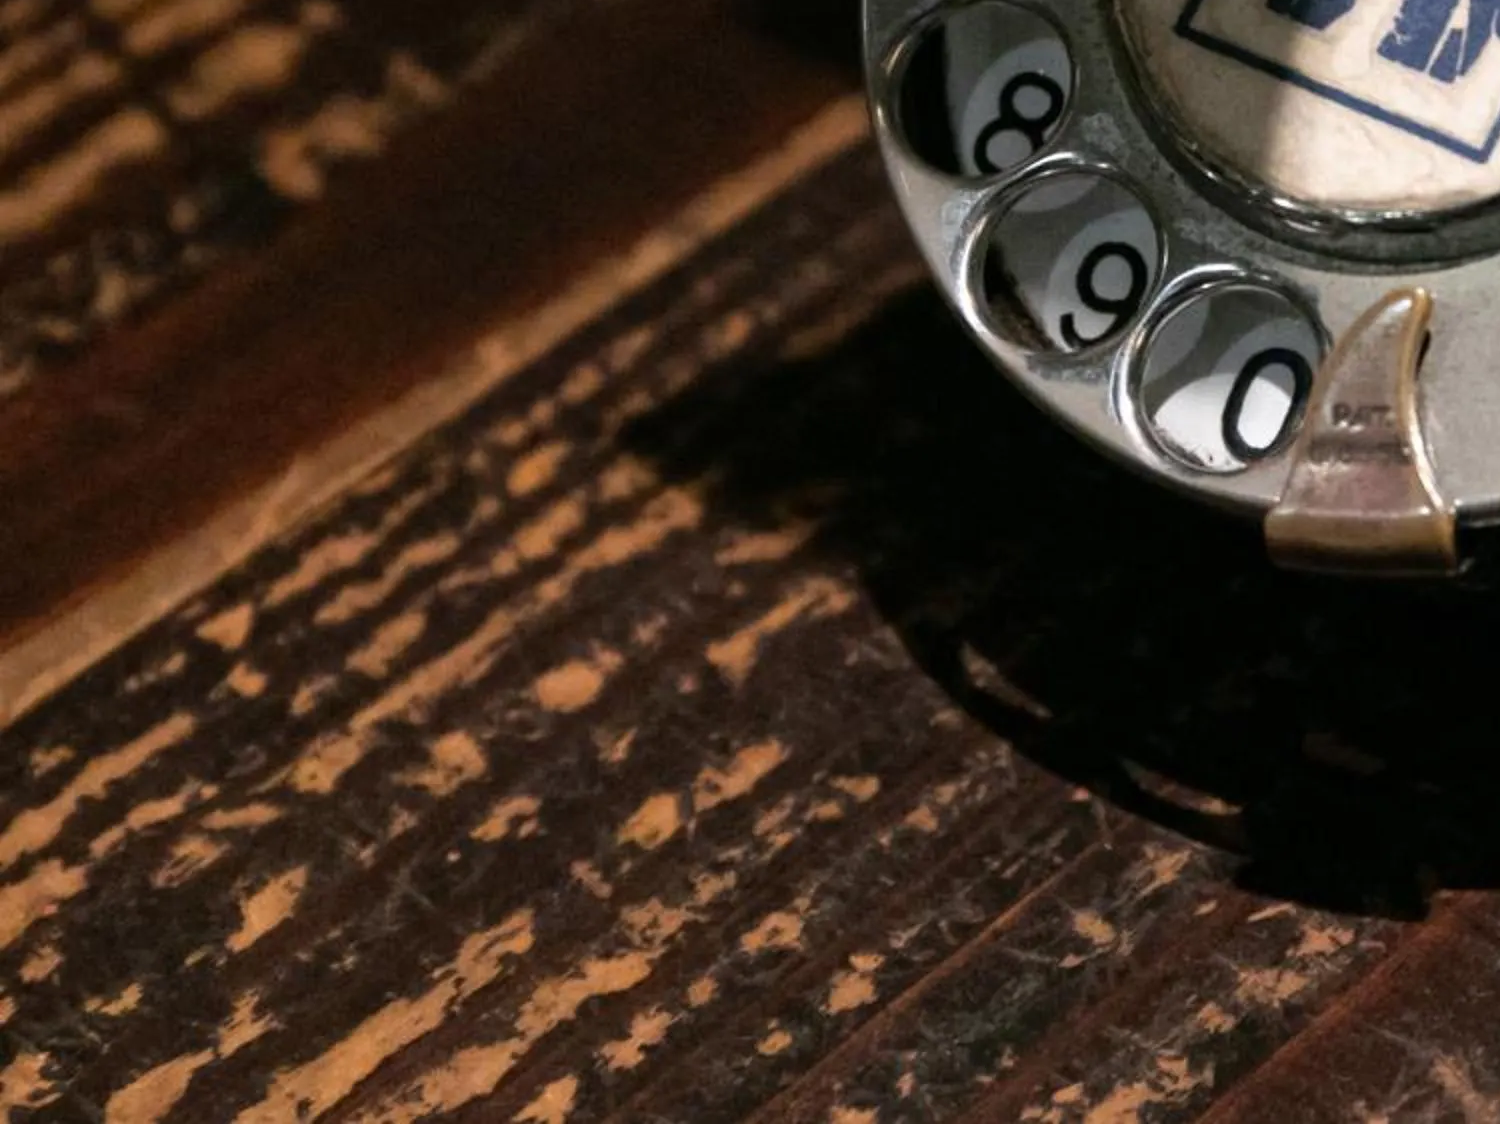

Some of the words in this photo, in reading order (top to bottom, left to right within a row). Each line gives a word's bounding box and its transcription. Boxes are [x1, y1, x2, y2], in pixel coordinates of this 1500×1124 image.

[974, 71, 1063, 173] 8
[1060, 242, 1148, 350] 9
[1222, 348, 1314, 458] 0
